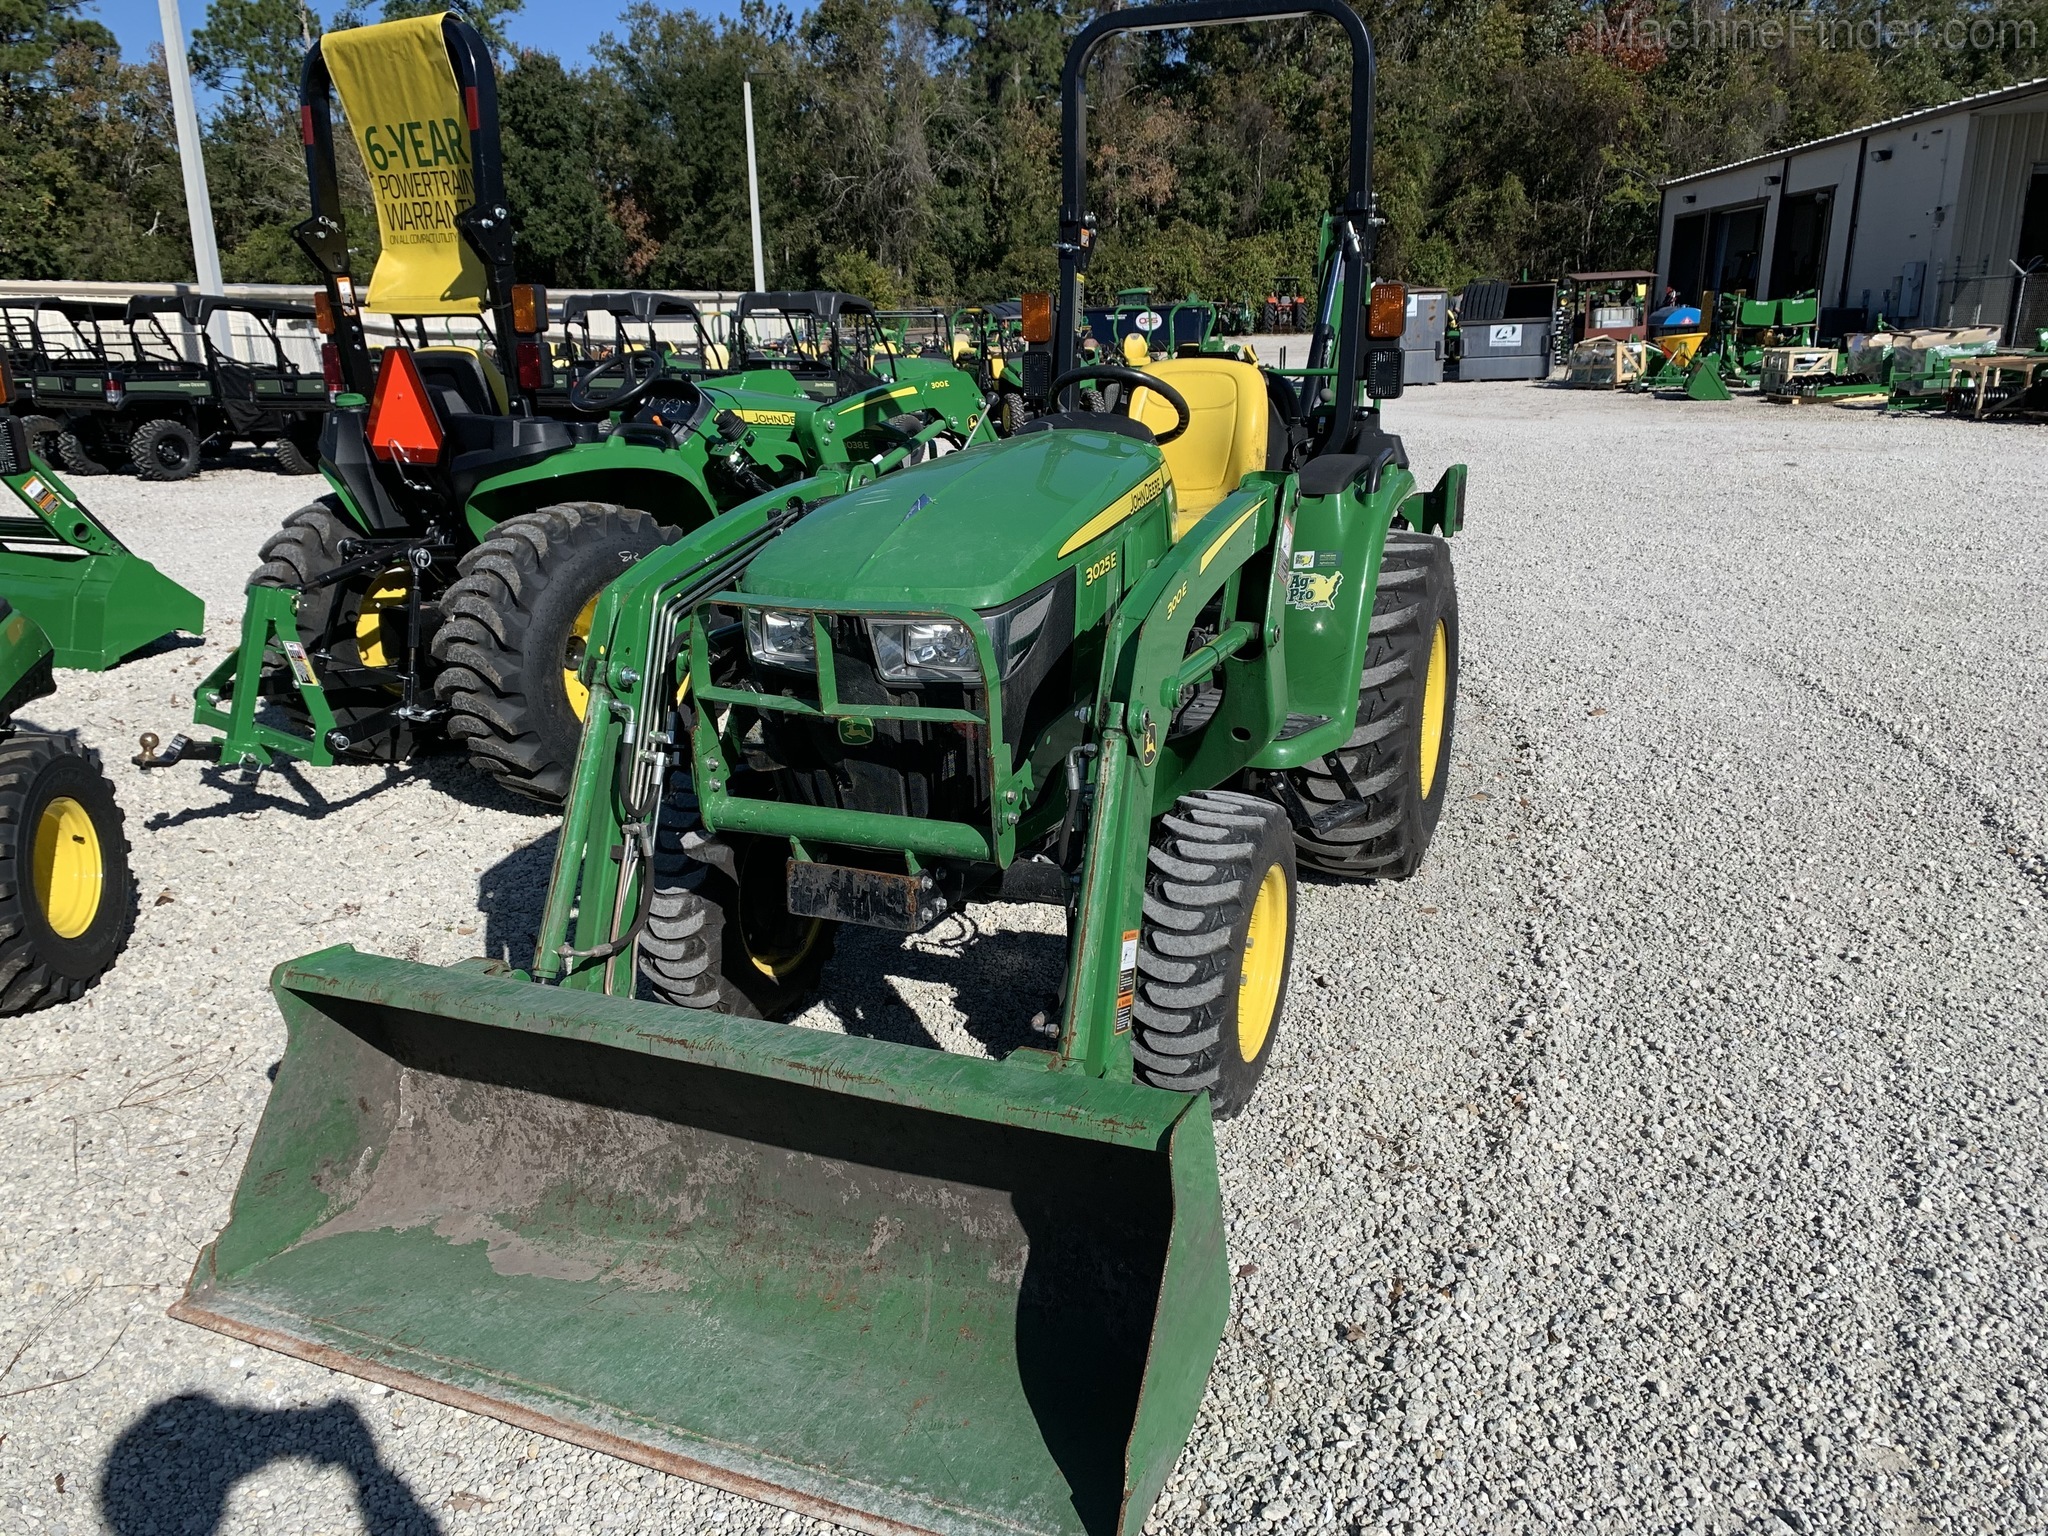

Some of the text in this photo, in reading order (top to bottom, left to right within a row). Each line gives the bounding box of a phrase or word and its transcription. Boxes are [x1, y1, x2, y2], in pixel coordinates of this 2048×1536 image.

[365, 118, 470, 171] 6-YEAR
[378, 169, 475, 199] POWERTRAIN
[400, 234, 409, 244] ALL
[410, 233, 434, 244] COMPACT
[752, 412, 781, 425] JOHN
[1130, 477, 1163, 514] JOHN DEERE
[1085, 551, 1117, 587] 3025E
[1290, 574, 1315, 590] Ag-
[1289, 589, 1314, 601] Pro
